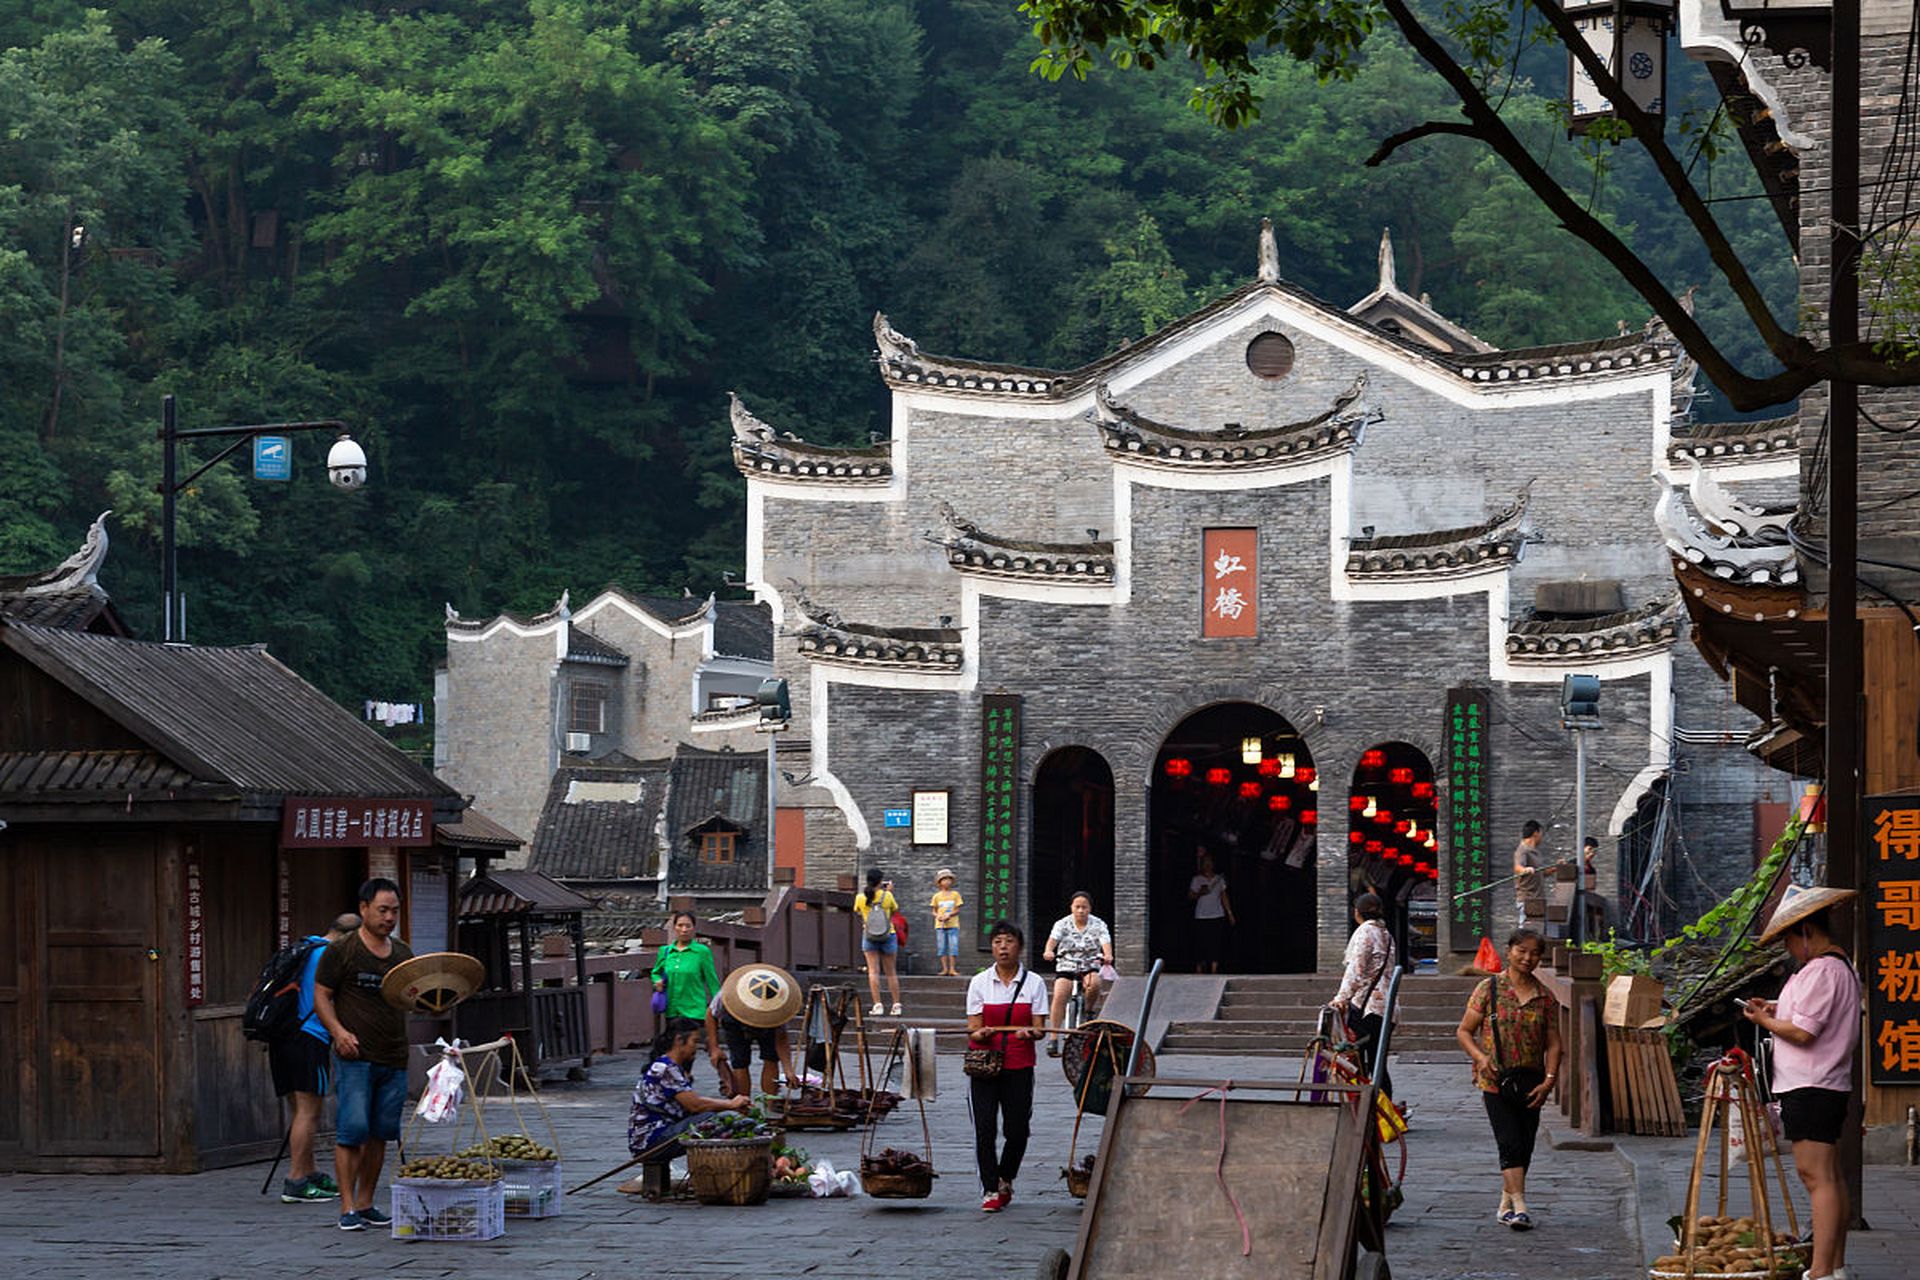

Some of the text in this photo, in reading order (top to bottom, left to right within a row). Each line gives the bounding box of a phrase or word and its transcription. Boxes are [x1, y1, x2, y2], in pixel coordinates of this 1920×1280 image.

[1212, 548, 1248, 620] 虹橋
[295, 807, 424, 839] 凤凰苗寨一日游报名点
[1873, 808, 1920, 1073] 得哥粉馆
